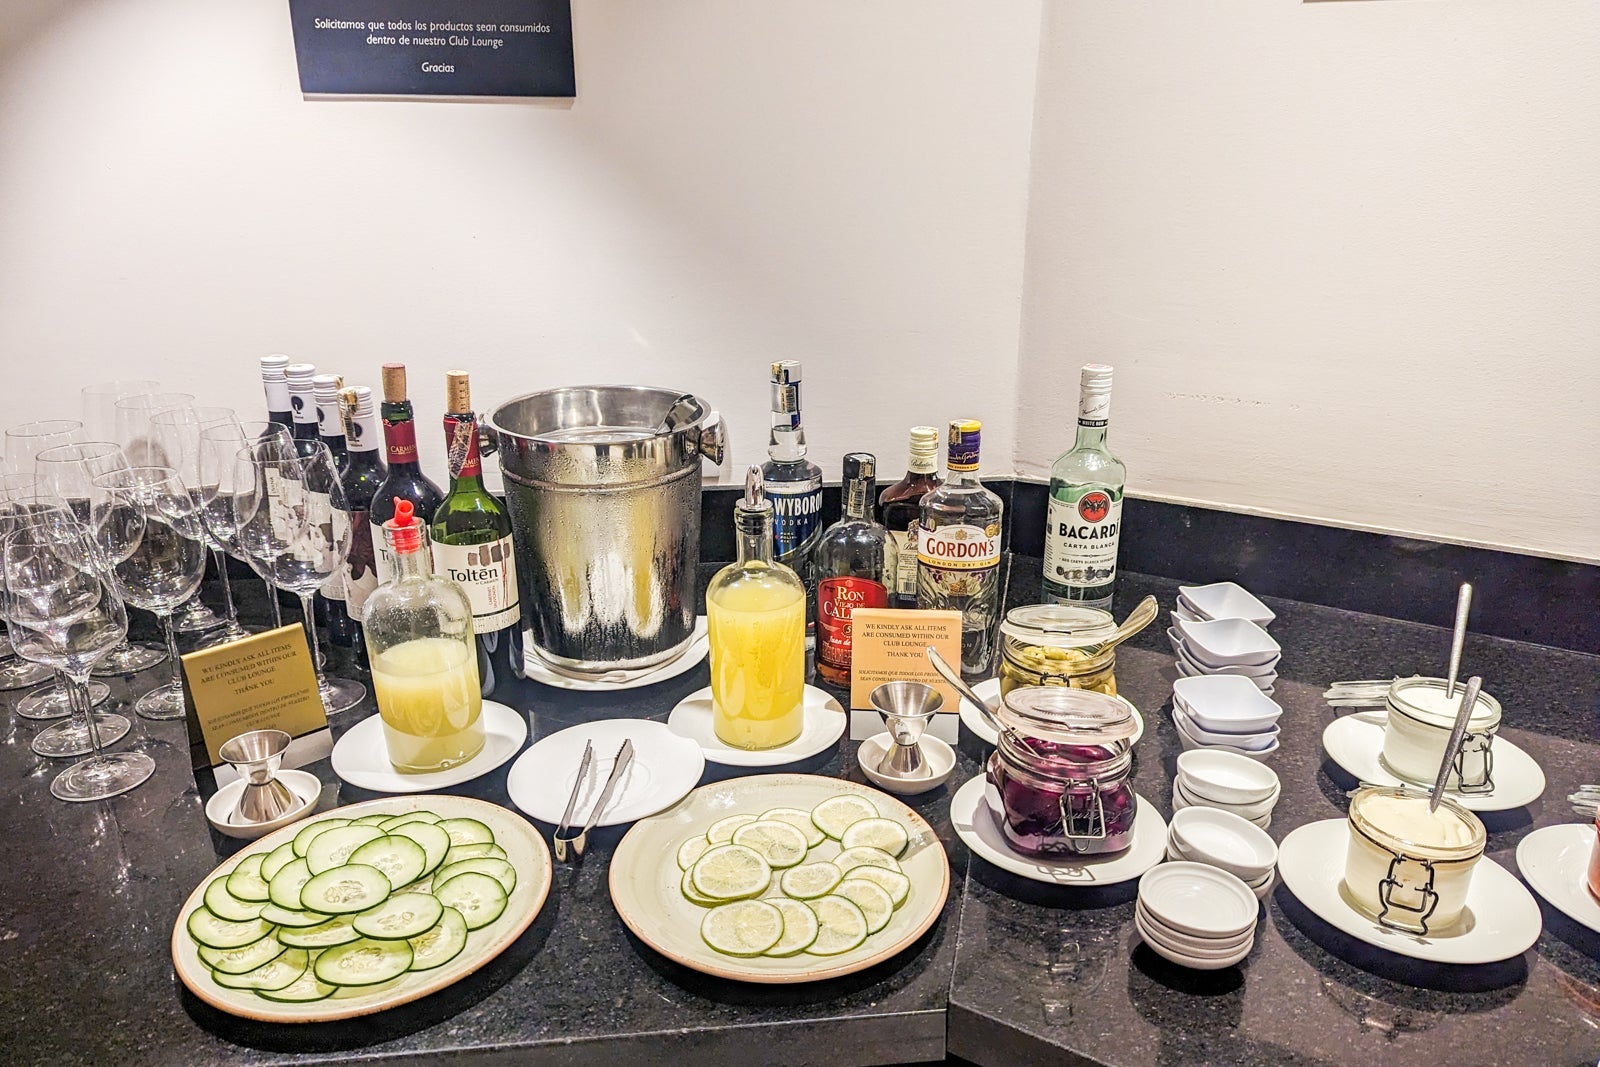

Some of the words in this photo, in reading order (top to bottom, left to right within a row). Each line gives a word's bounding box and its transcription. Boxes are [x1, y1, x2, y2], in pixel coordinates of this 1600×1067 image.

[314, 18, 365, 30] Solicitamos
[368, 21, 385, 32] que
[388, 20, 412, 31] todos
[415, 20, 427, 31] los
[430, 21, 474, 33] productos
[476, 23, 497, 32] sean
[500, 22, 551, 33] consumidos
[366, 35, 397, 46] dentro
[399, 35, 411, 46] de
[413, 36, 446, 46] nuestro
[448, 36, 469, 47] Club
[472, 36, 503, 49] Lounge
[421, 62, 455, 73] Gracias
[390, 444, 416, 453] CARMEN
[774, 518, 809, 526] VODKA
[927, 537, 994, 558] GORDON'S
[1091, 542, 1115, 550] BLANCA
[928, 559, 958, 567] LONDON
[837, 586, 864, 601] RON
[824, 601, 853, 618] CAL
[200, 674, 215, 684] ARE
[216, 663, 256, 680] CONSUMED
[256, 655, 283, 667] WITHIN
[282, 650, 297, 660] OUR
[201, 667, 214, 675] WE
[215, 658, 242, 671] KINDLY
[242, 655, 256, 664] ASK
[257, 650, 270, 660] ALL
[271, 644, 292, 654] ITEMS
[227, 676, 247, 686] CLUB
[247, 666, 277, 680] LOUNGE
[234, 684, 260, 696] THANK
[260, 678, 275, 689] YOU
